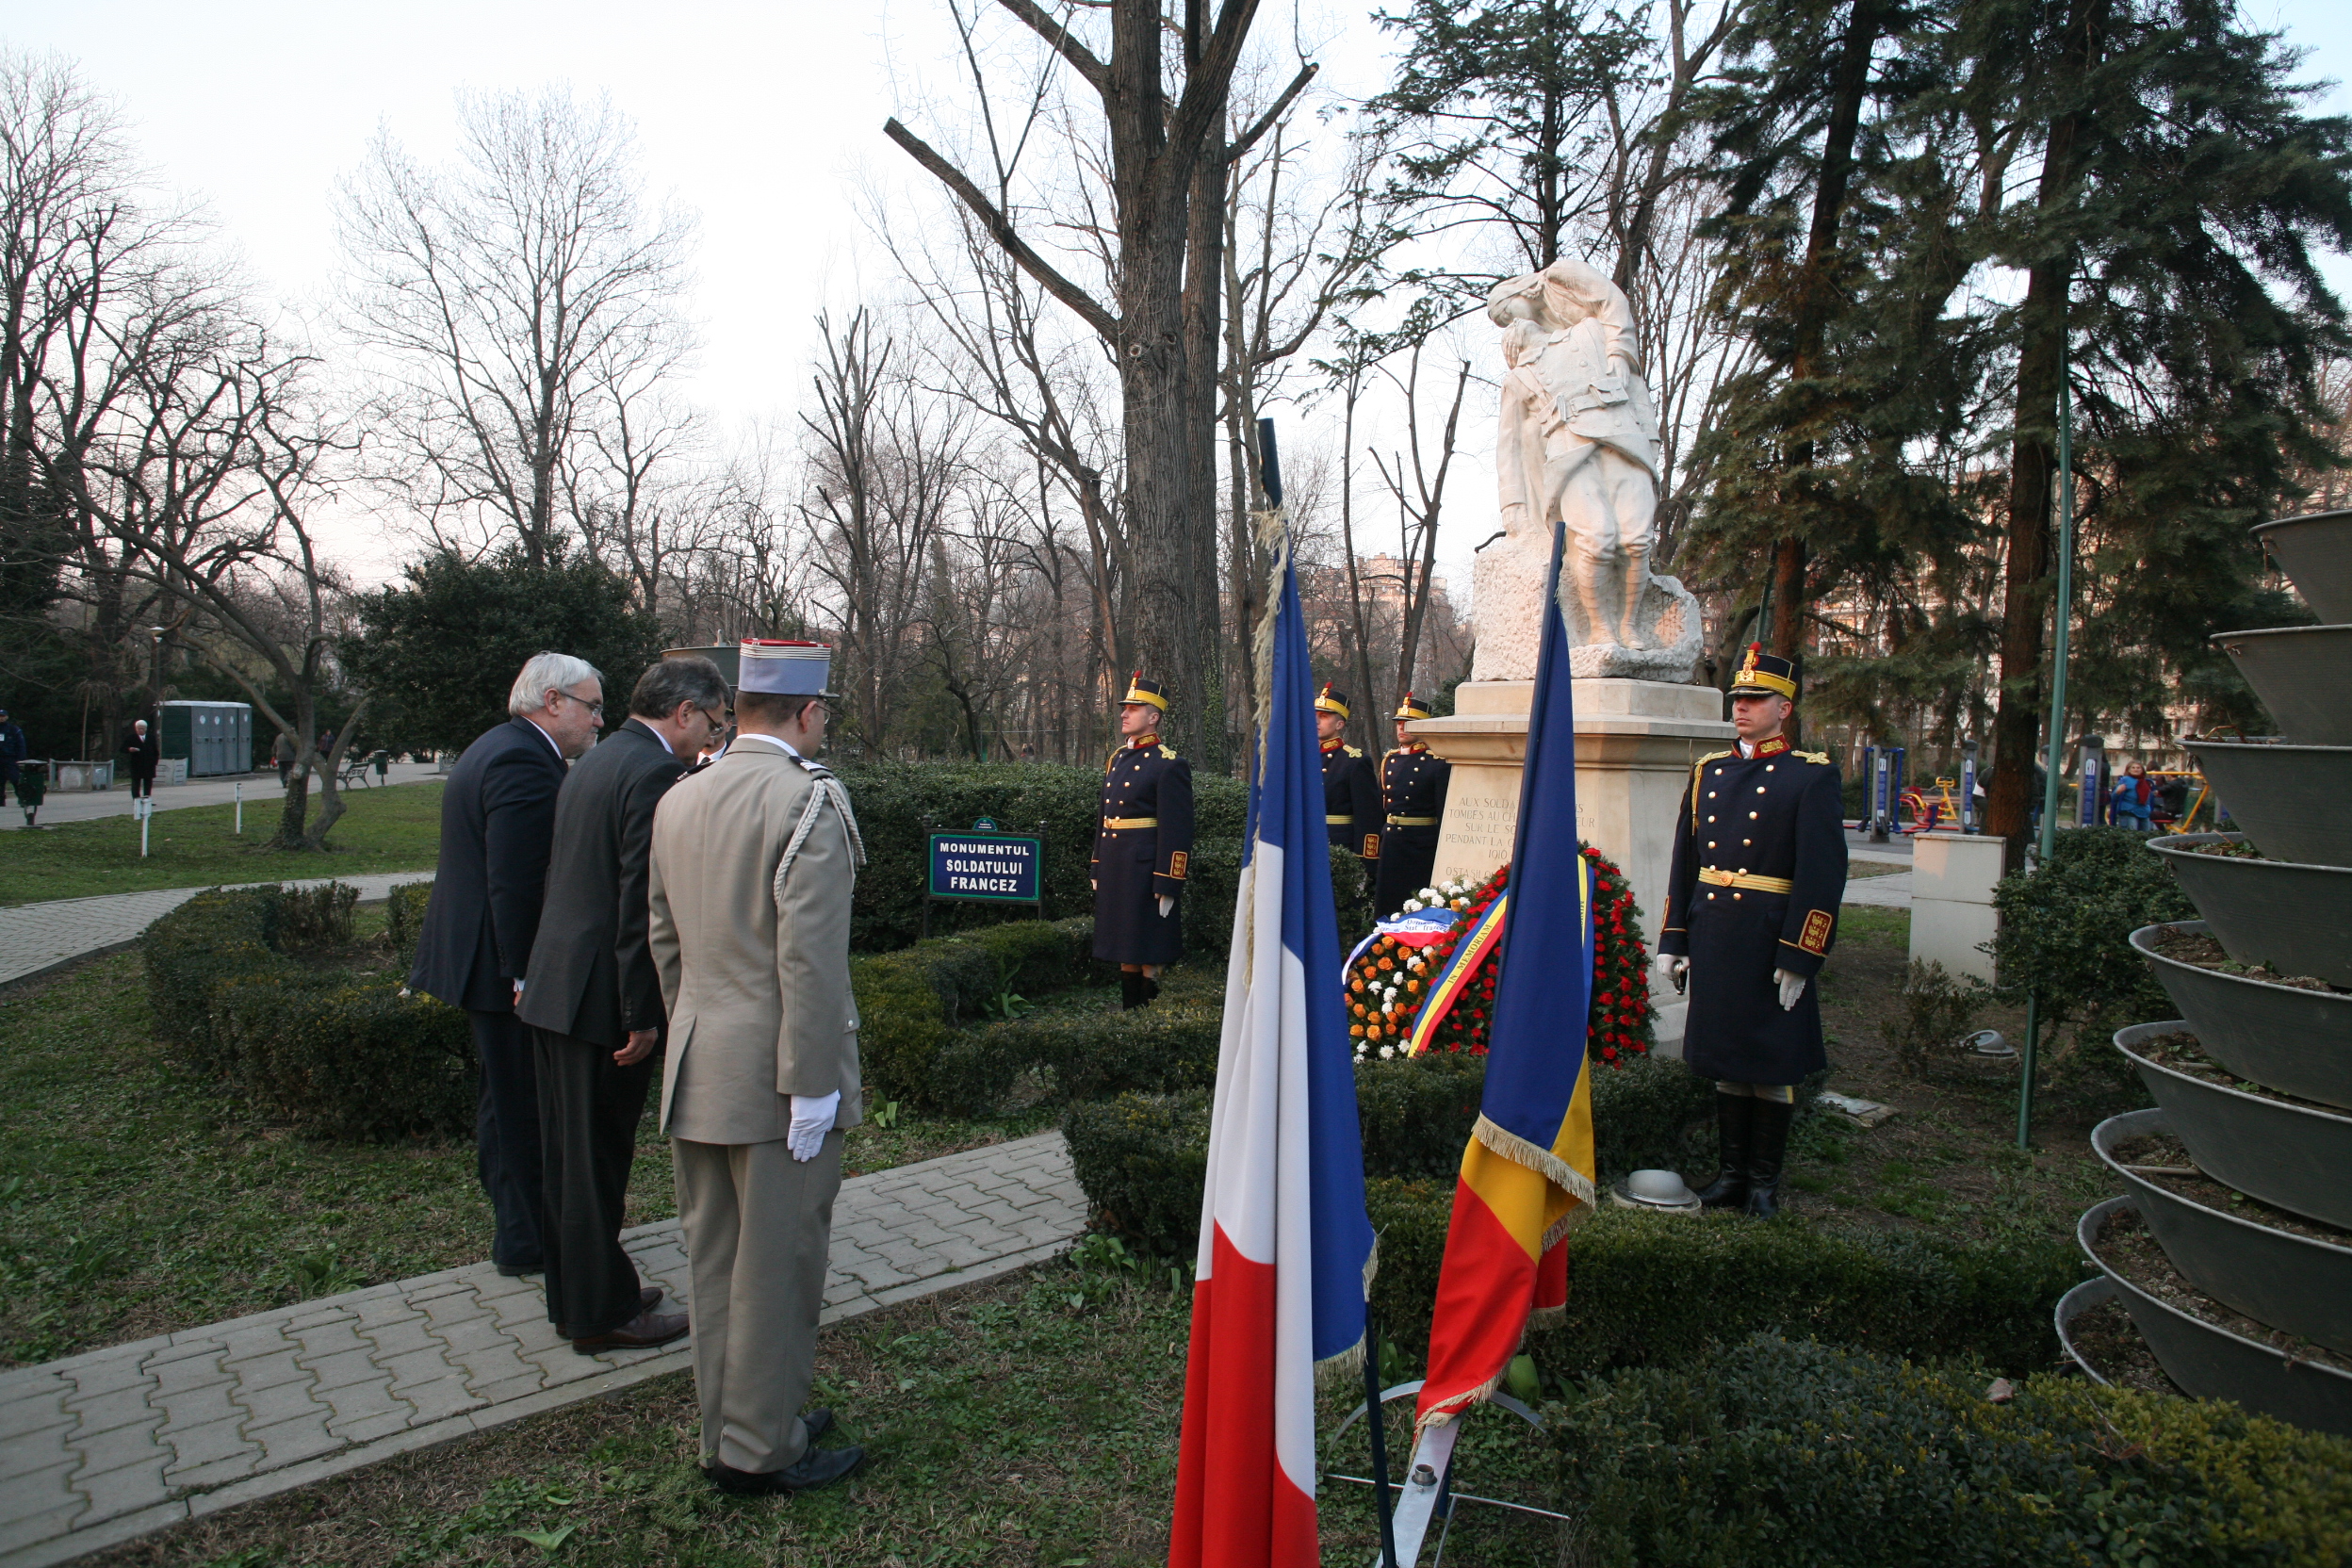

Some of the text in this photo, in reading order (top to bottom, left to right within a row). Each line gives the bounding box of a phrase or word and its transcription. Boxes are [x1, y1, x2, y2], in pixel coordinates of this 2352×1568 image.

[1459, 797, 1519, 808] AUX SOLDA
[1487, 811, 1500, 822] AU
[1465, 823, 1483, 832] SUR
[1487, 824, 1499, 833] LE
[1446, 834, 1488, 844] PENDANT
[1490, 837, 1503, 846] LA
[939, 842, 1030, 856] MONUMENTUL
[946, 859, 1022, 874] SOLDATULUI
[950, 876, 1018, 892] FRANCEZ
[1447, 923, 1493, 984] IN MEMORIAM
